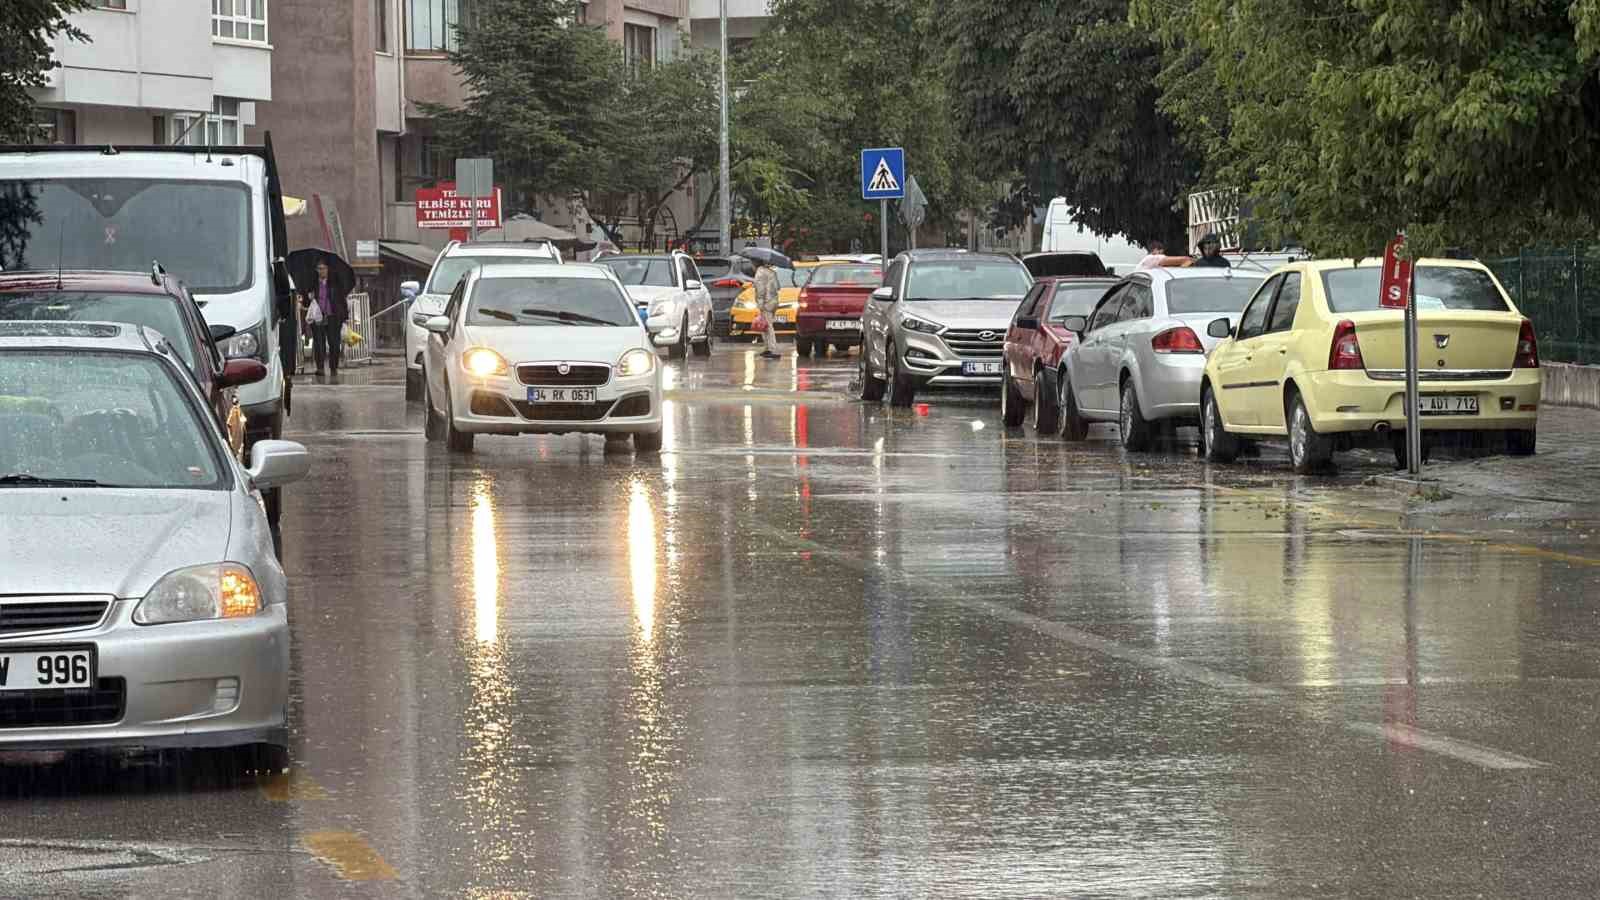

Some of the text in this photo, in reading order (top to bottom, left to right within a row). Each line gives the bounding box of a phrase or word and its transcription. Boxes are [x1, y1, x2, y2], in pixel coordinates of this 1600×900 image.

[418, 198, 456, 209] ELBİSE
[552, 390, 565, 400] RK
[1456, 398, 1475, 409] 712
[37, 655, 87, 685] 996
